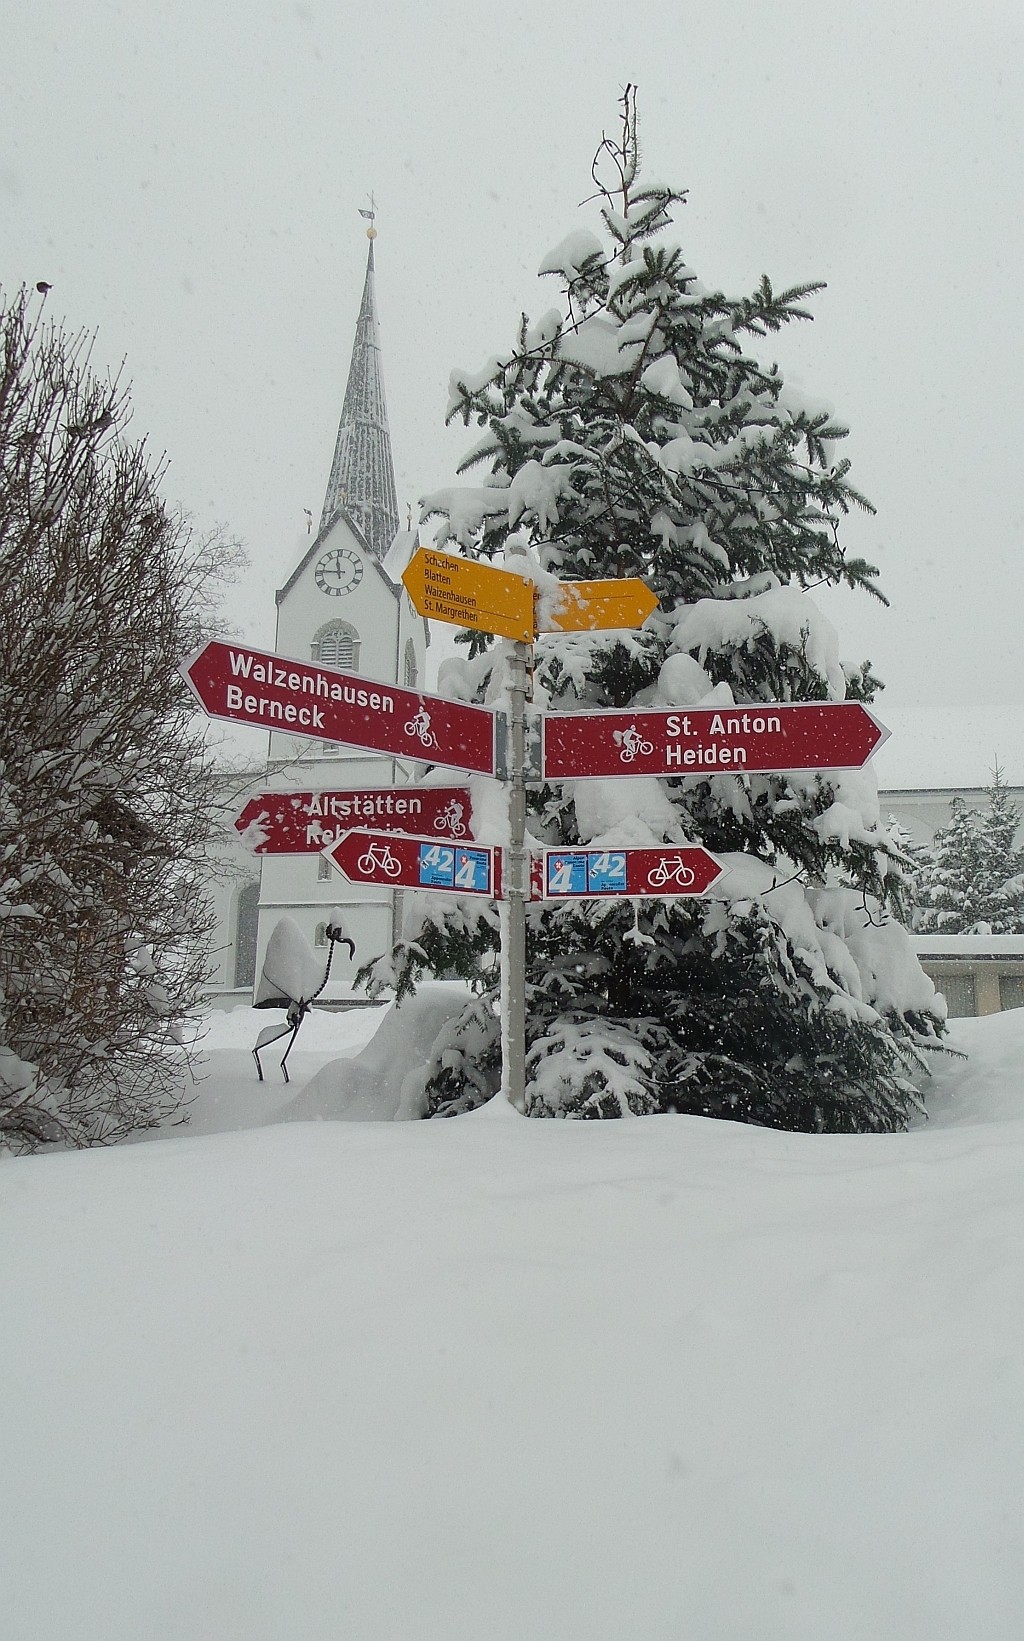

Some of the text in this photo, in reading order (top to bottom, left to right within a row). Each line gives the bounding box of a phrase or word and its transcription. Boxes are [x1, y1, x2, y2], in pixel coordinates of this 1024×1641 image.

[424, 569, 451, 585] Blatten
[424, 600, 478, 622] St. Margrethen
[229, 651, 394, 714] Walzenhausen
[226, 684, 326, 729] Berneck
[666, 713, 781, 737] St. Anton
[666, 744, 747, 765] Heiden
[307, 794, 422, 816] Altstätten
[424, 846, 454, 872] 42
[593, 853, 625, 877] 42
[455, 860, 476, 888] 4
[549, 864, 572, 893] 4
